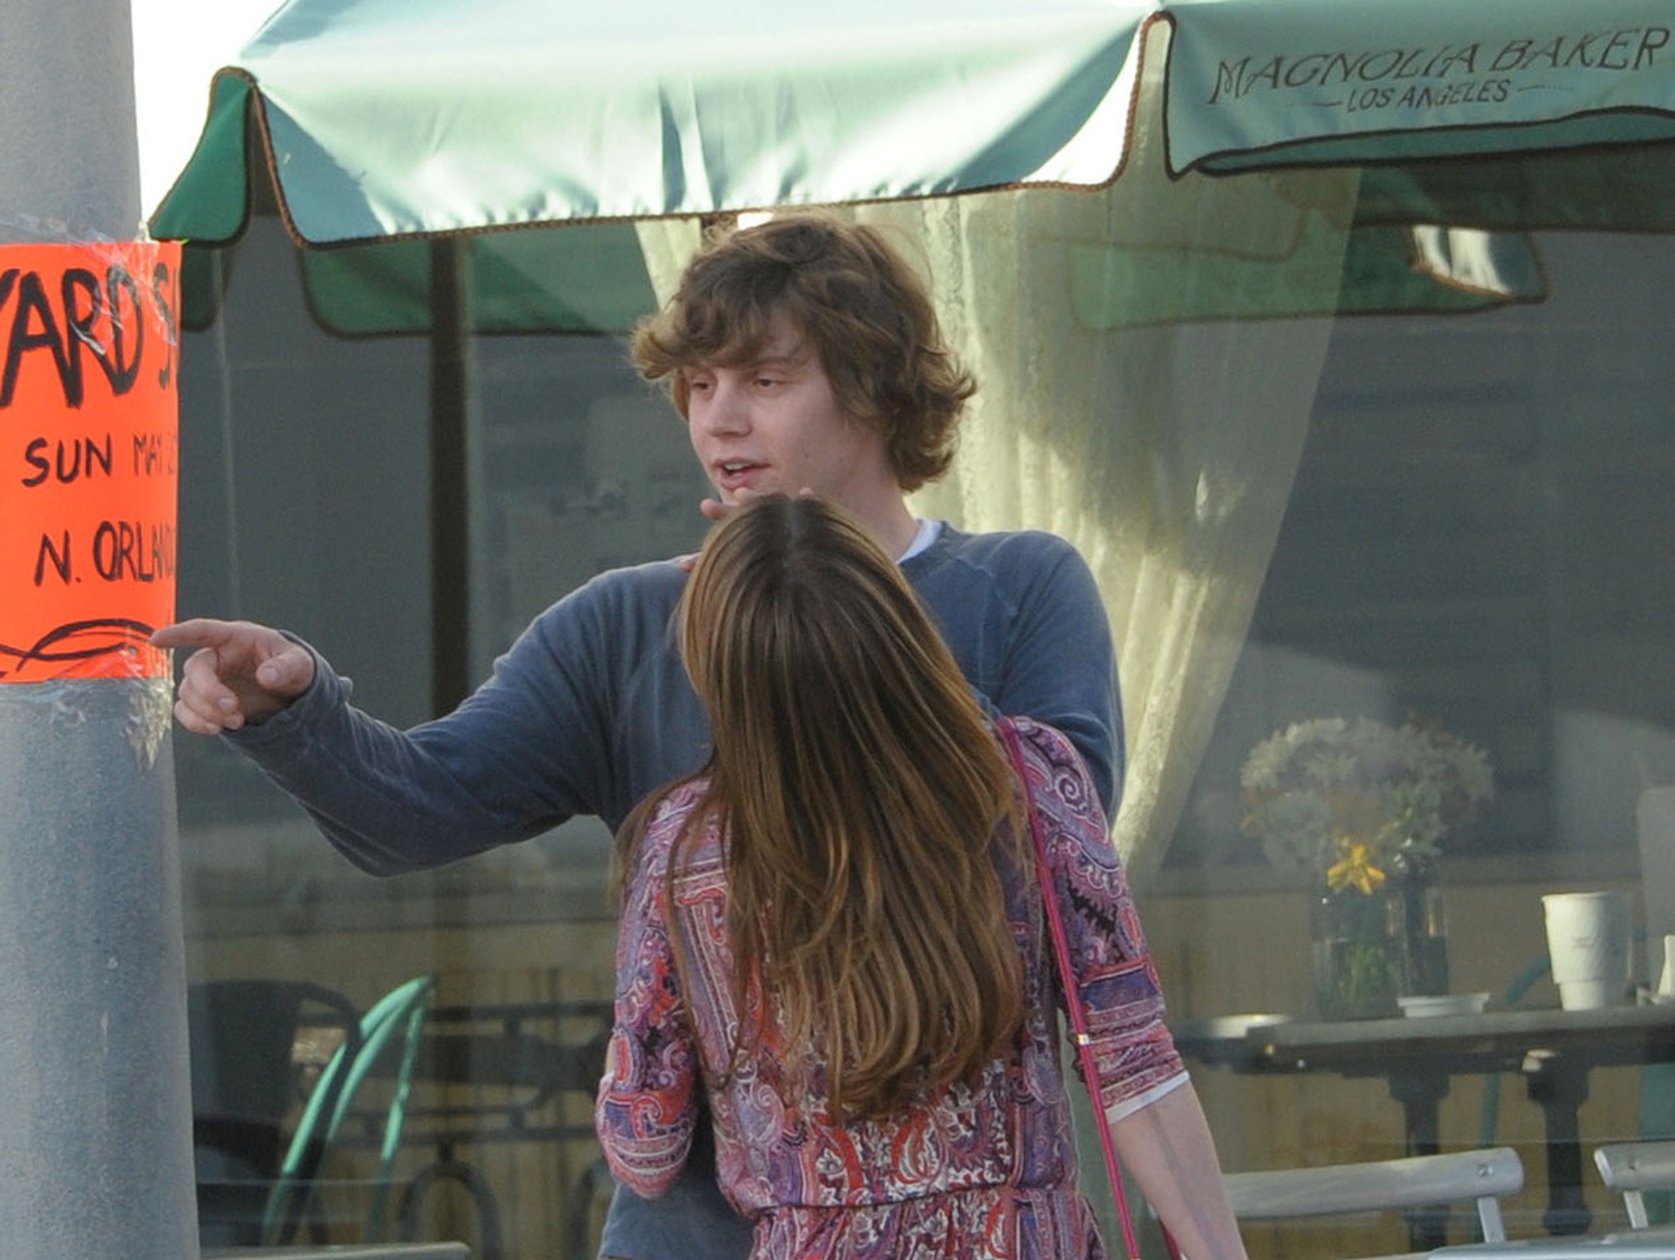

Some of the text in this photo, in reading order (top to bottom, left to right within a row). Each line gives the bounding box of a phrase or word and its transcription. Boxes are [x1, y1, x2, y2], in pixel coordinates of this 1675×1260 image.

[1208, 27, 1670, 104] MAGNOLIA BAKER
[1347, 79, 1511, 112] LOS ANGELES
[21, 432, 111, 487] SUN
[34, 528, 82, 587] N.
